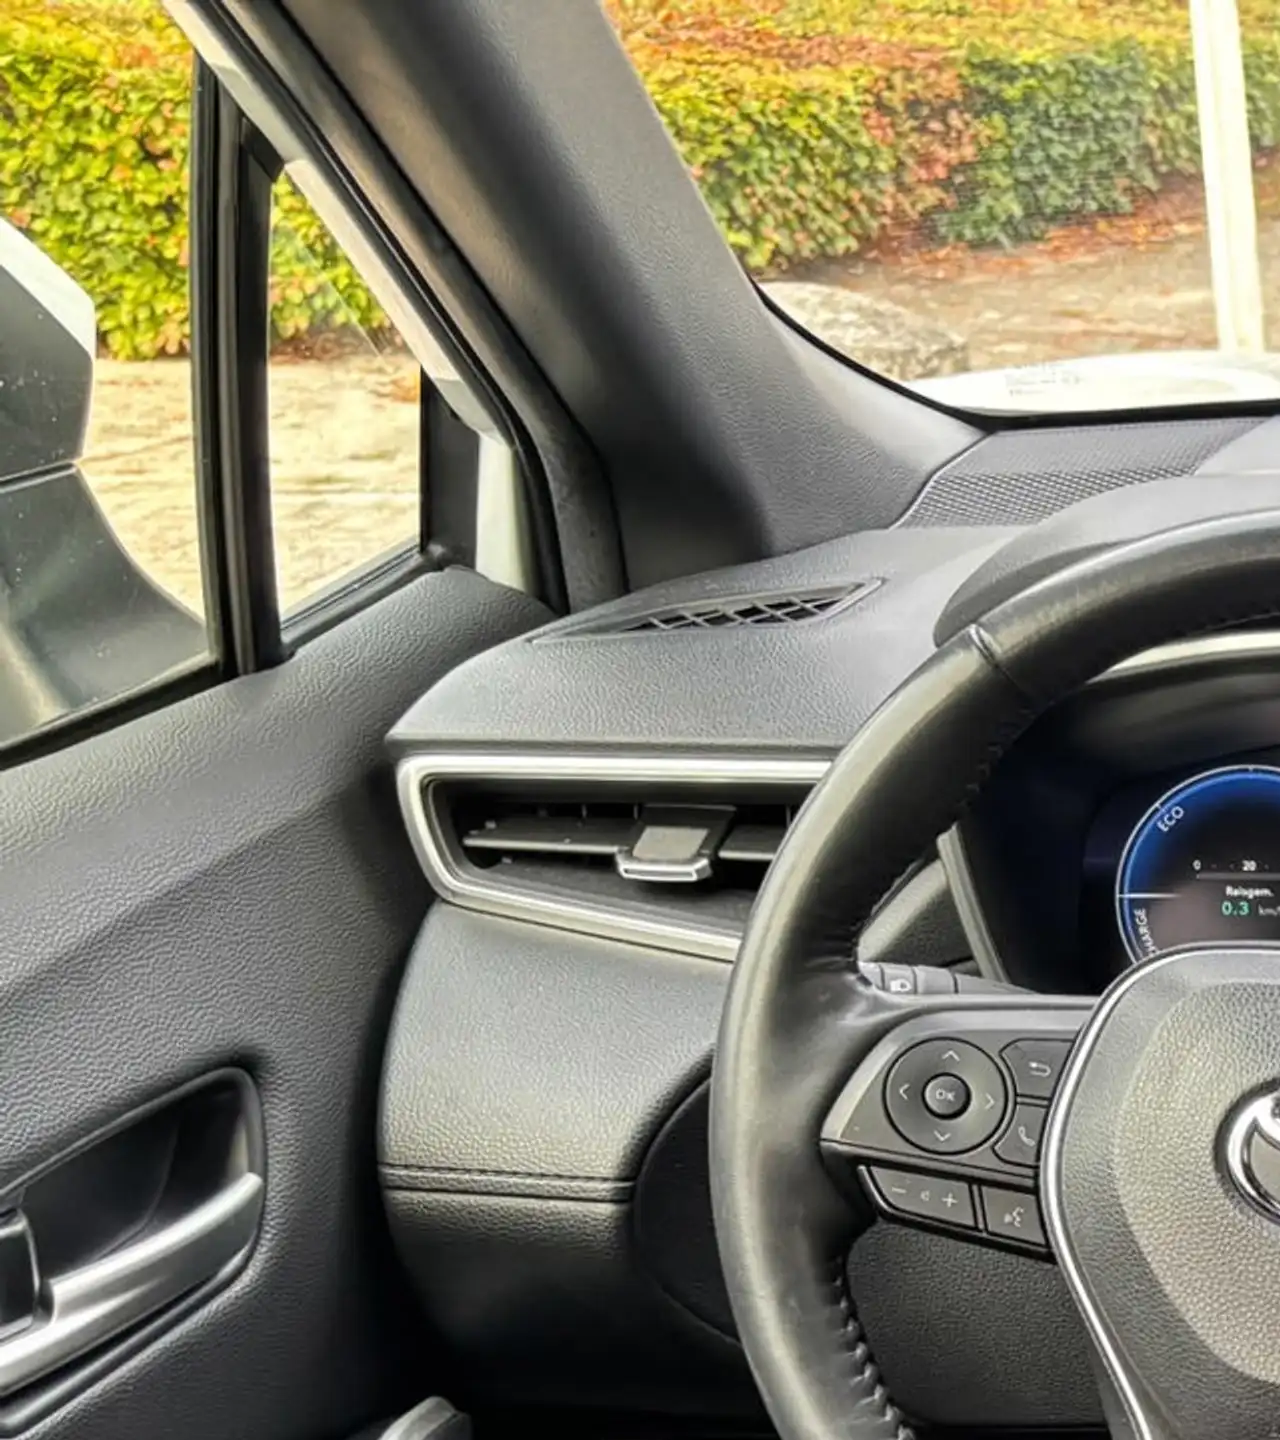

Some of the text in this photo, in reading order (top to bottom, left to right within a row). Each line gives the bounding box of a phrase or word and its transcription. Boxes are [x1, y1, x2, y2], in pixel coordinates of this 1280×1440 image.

[1157, 805, 1185, 832] ECO
[1222, 901, 1249, 915] 0.3
[935, 1088, 956, 1101] OK
